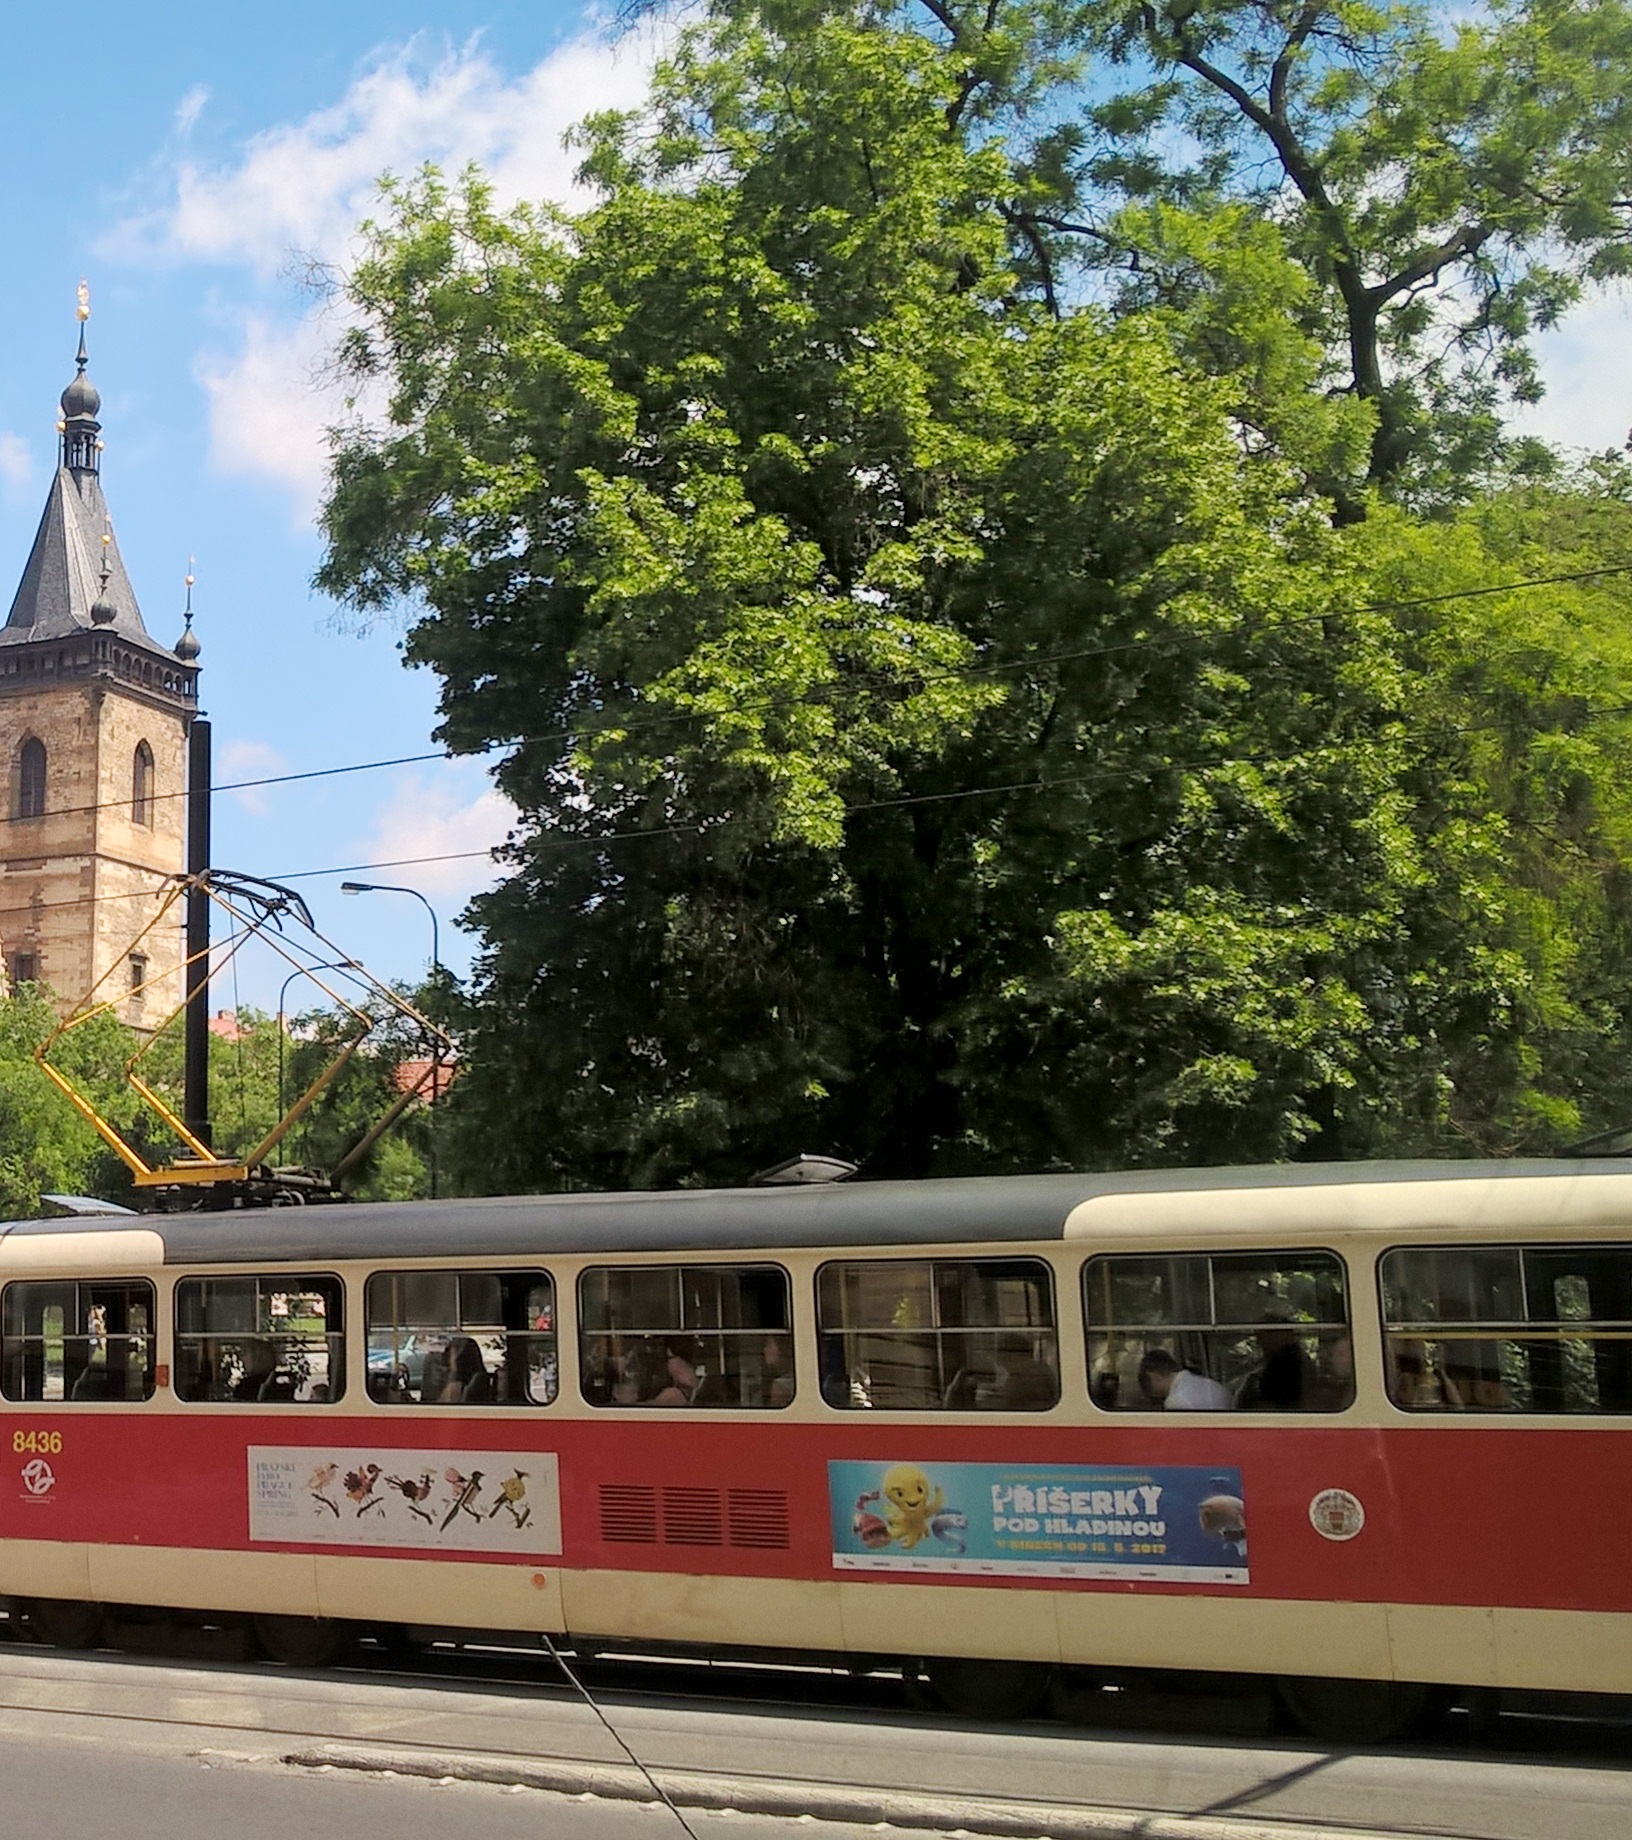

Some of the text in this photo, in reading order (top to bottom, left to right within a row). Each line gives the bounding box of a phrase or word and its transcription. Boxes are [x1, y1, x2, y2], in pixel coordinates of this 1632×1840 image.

[13, 1430, 63, 1454] 8436
[991, 1484, 1163, 1516] PŘÍŠERKY
[993, 1516, 1166, 1537] POD HLADINOU
